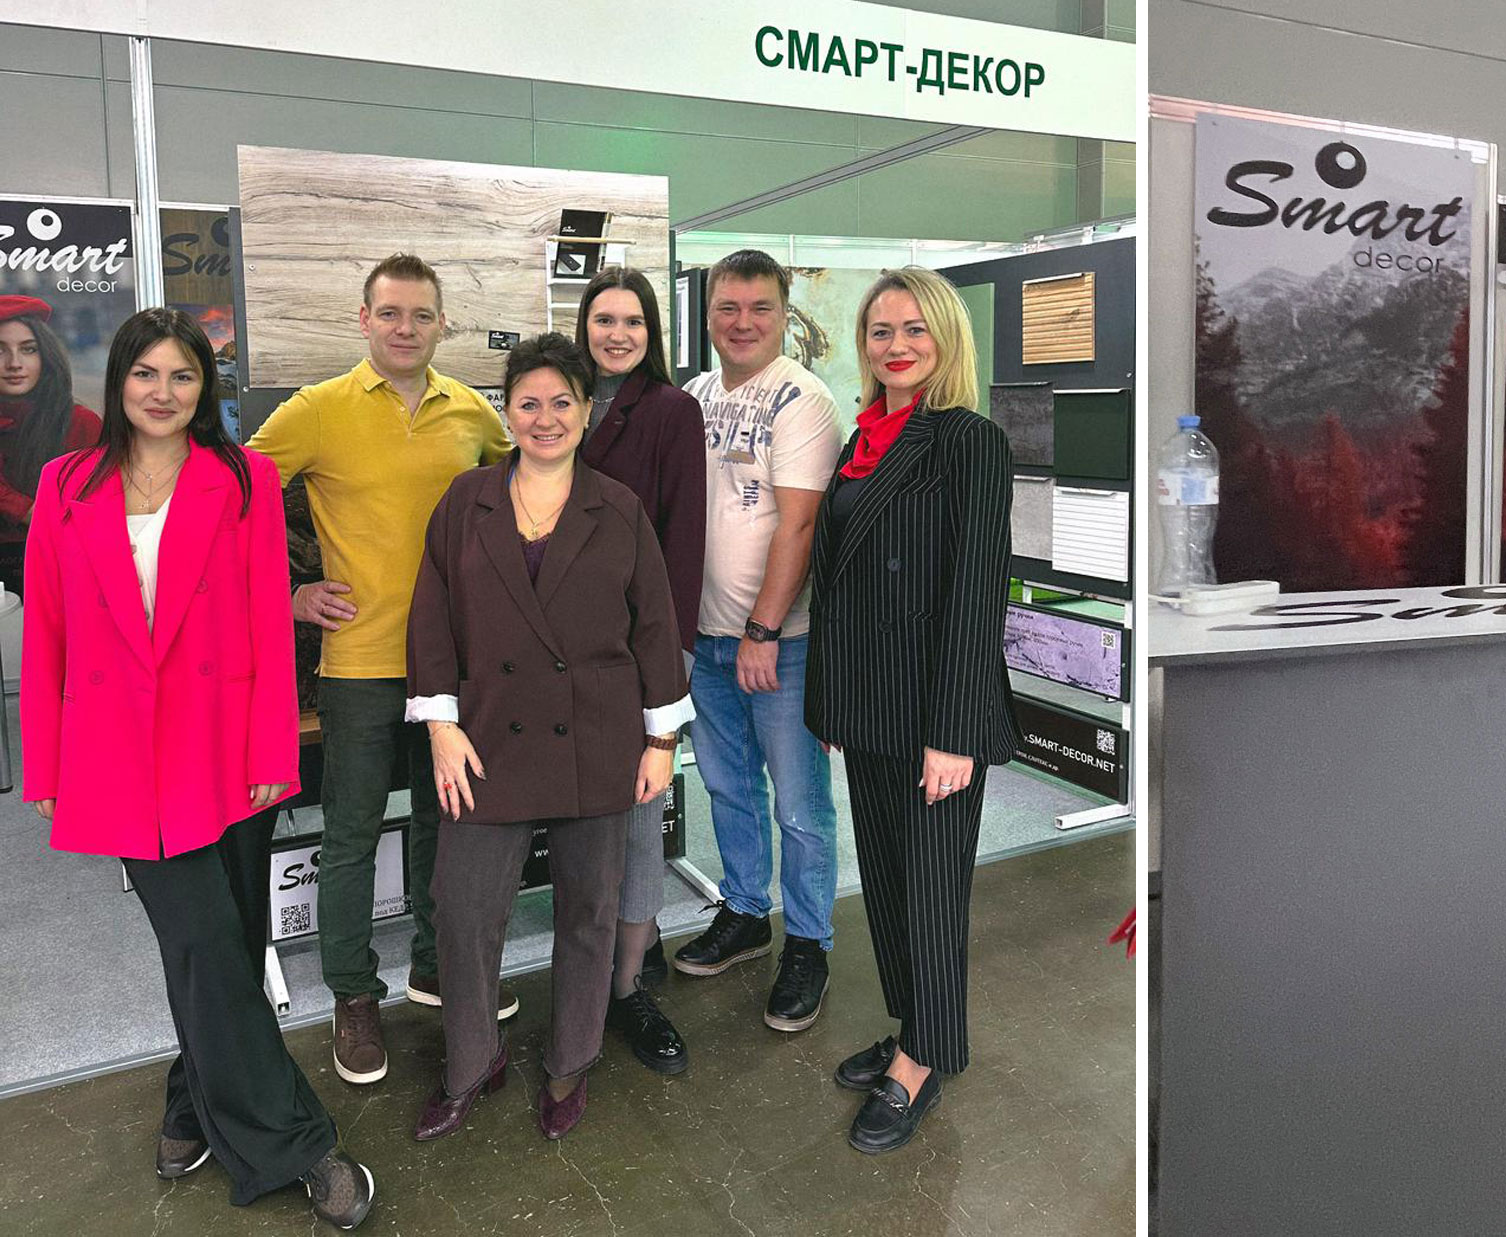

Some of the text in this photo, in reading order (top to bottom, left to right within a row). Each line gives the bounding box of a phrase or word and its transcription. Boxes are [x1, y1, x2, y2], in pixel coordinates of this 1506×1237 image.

[754, 25, 1046, 99] СМАРТ-ДЕКОР
[1207, 160, 1464, 246] Smart
[0, 224, 128, 275] mart
[1353, 246, 1443, 274] decor
[56, 276, 118, 293] decor
